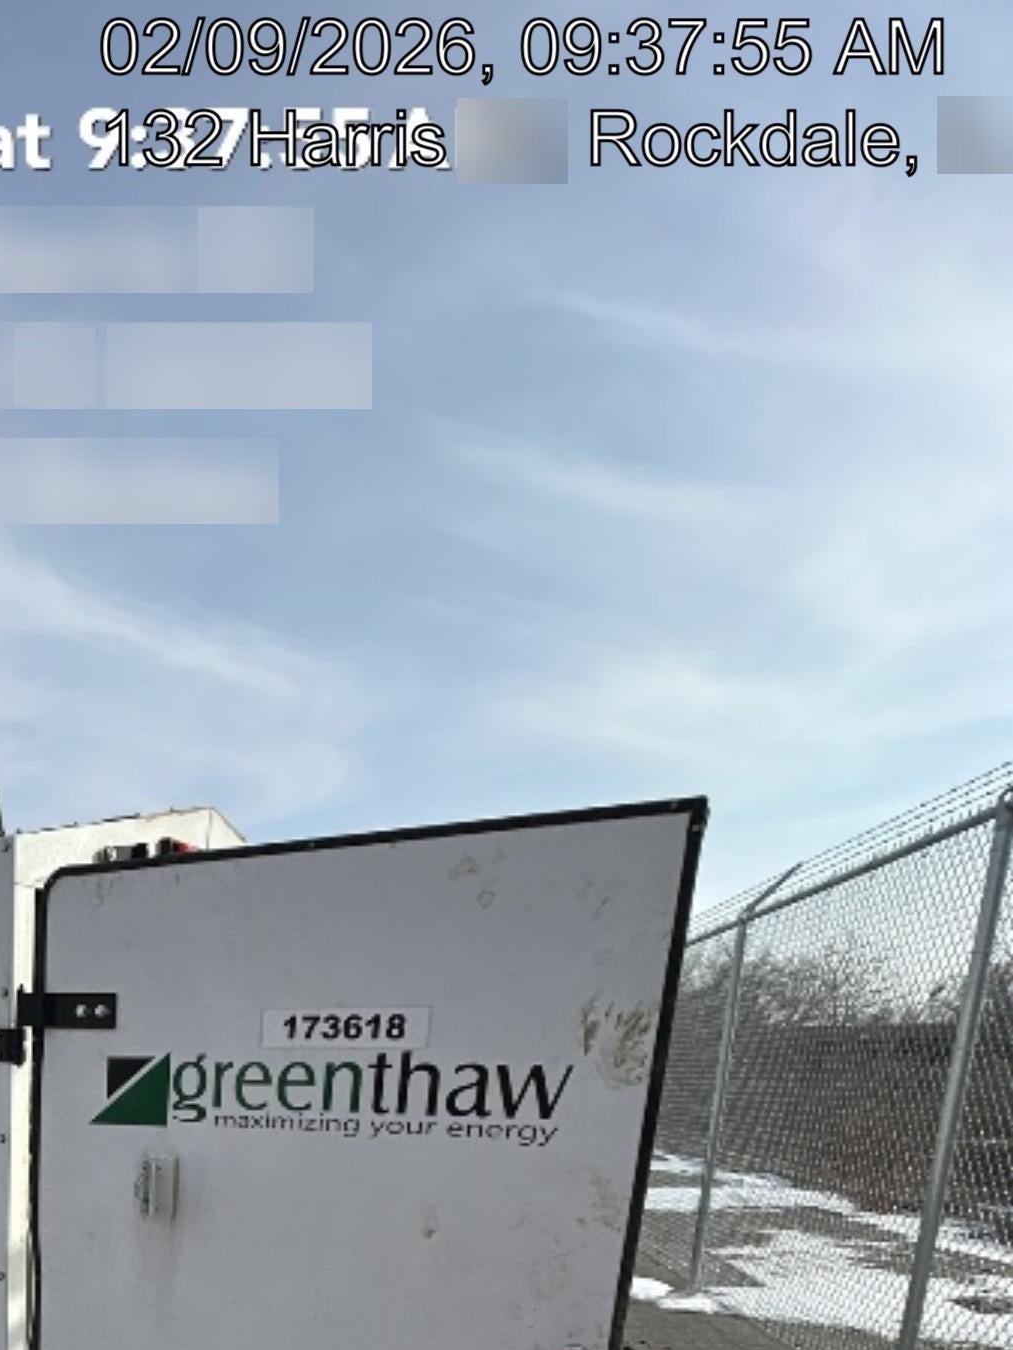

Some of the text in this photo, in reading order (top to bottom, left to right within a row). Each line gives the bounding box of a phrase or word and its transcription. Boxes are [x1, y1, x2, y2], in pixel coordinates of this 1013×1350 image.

[283, 1013, 408, 1040] 173618
[171, 1050, 574, 1123] greenthaw
[213, 1111, 559, 1147] maximizing your energy
